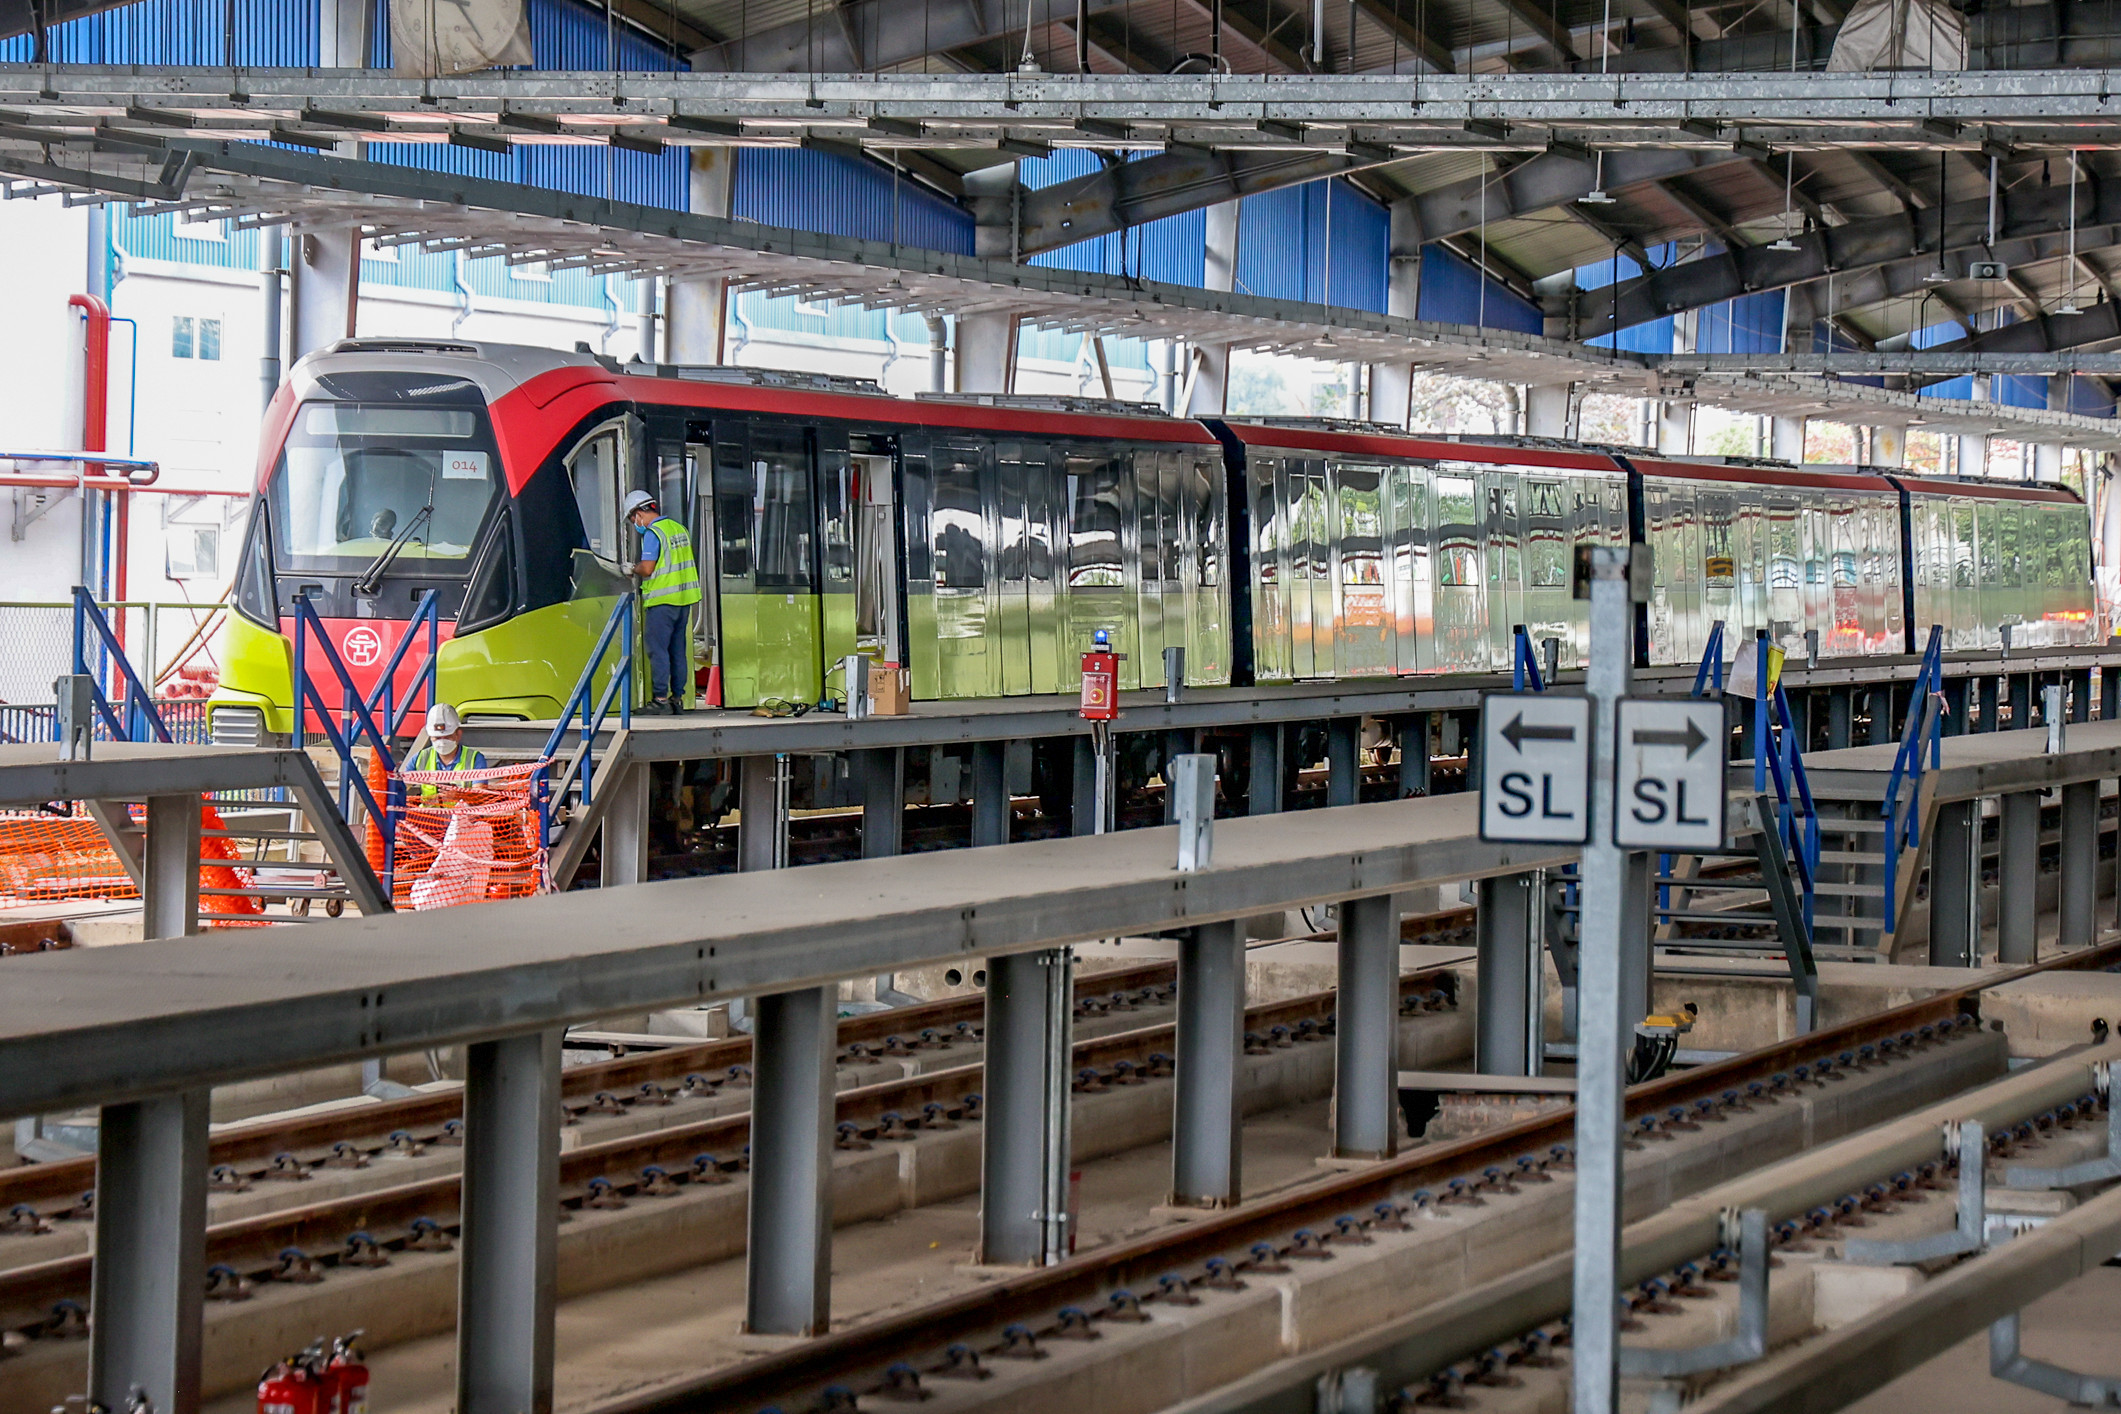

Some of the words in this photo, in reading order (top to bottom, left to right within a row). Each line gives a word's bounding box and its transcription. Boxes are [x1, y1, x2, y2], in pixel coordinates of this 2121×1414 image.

[452, 460, 477, 473] 014
[1498, 772, 1574, 819] SL
[1631, 777, 1709, 826] SL
